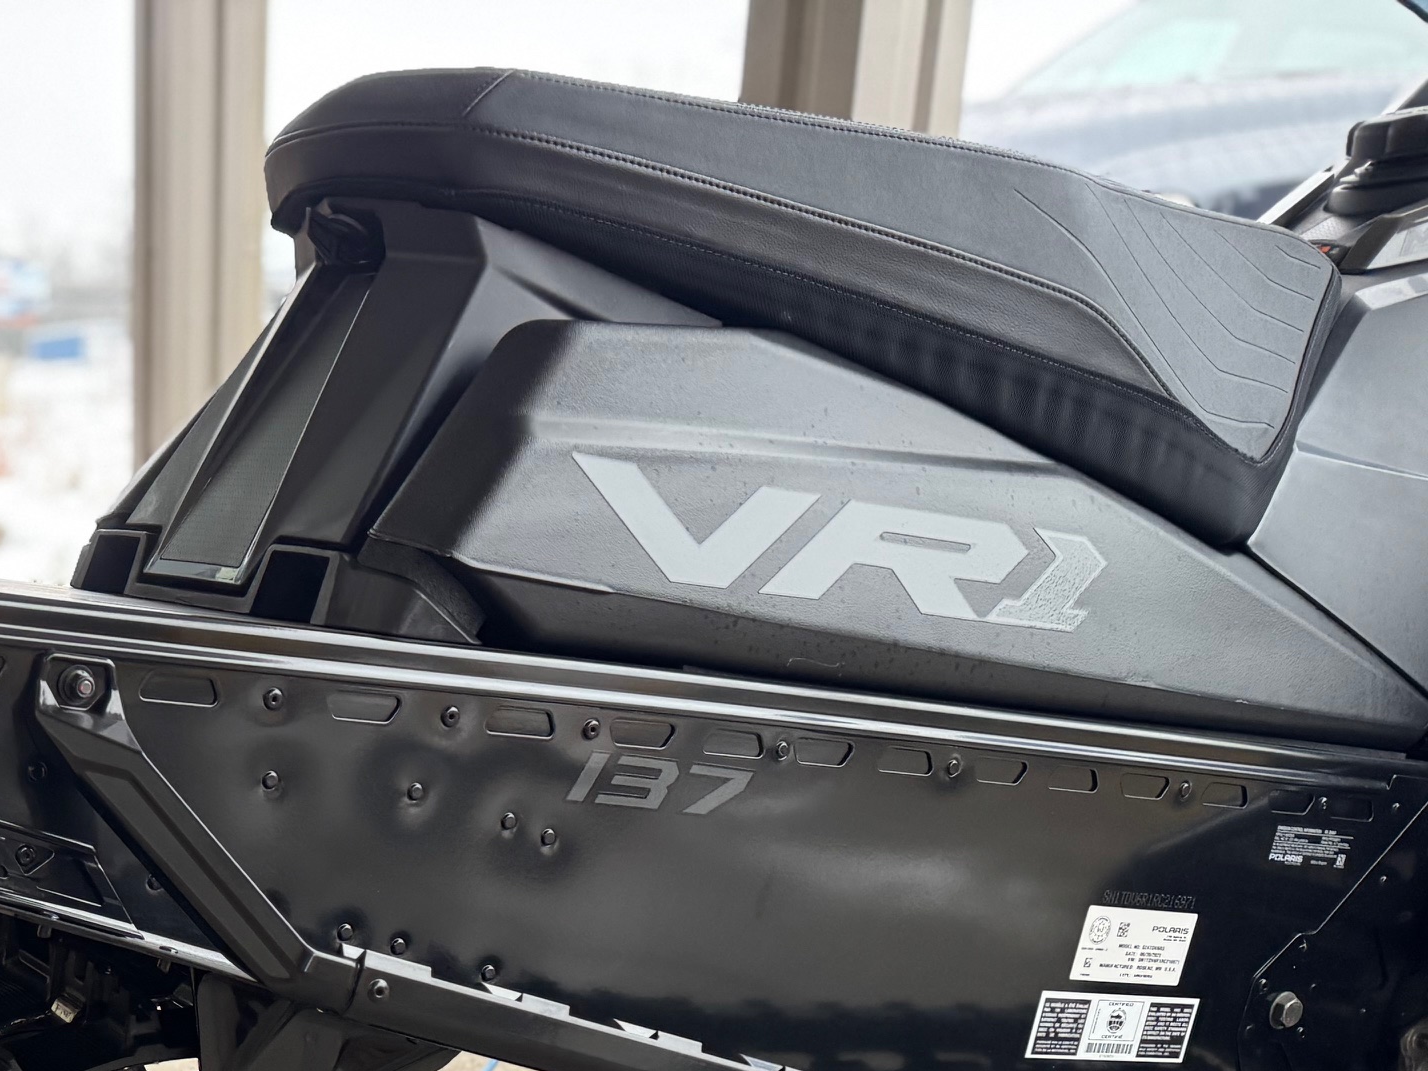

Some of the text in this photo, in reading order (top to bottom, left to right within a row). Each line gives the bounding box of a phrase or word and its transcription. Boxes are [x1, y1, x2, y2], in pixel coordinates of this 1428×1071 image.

[572, 451, 1108, 633] VR1
[565, 748, 757, 816] 137
[1268, 853, 1304, 862] POLARIS
[1152, 925, 1190, 935] POLARIS
